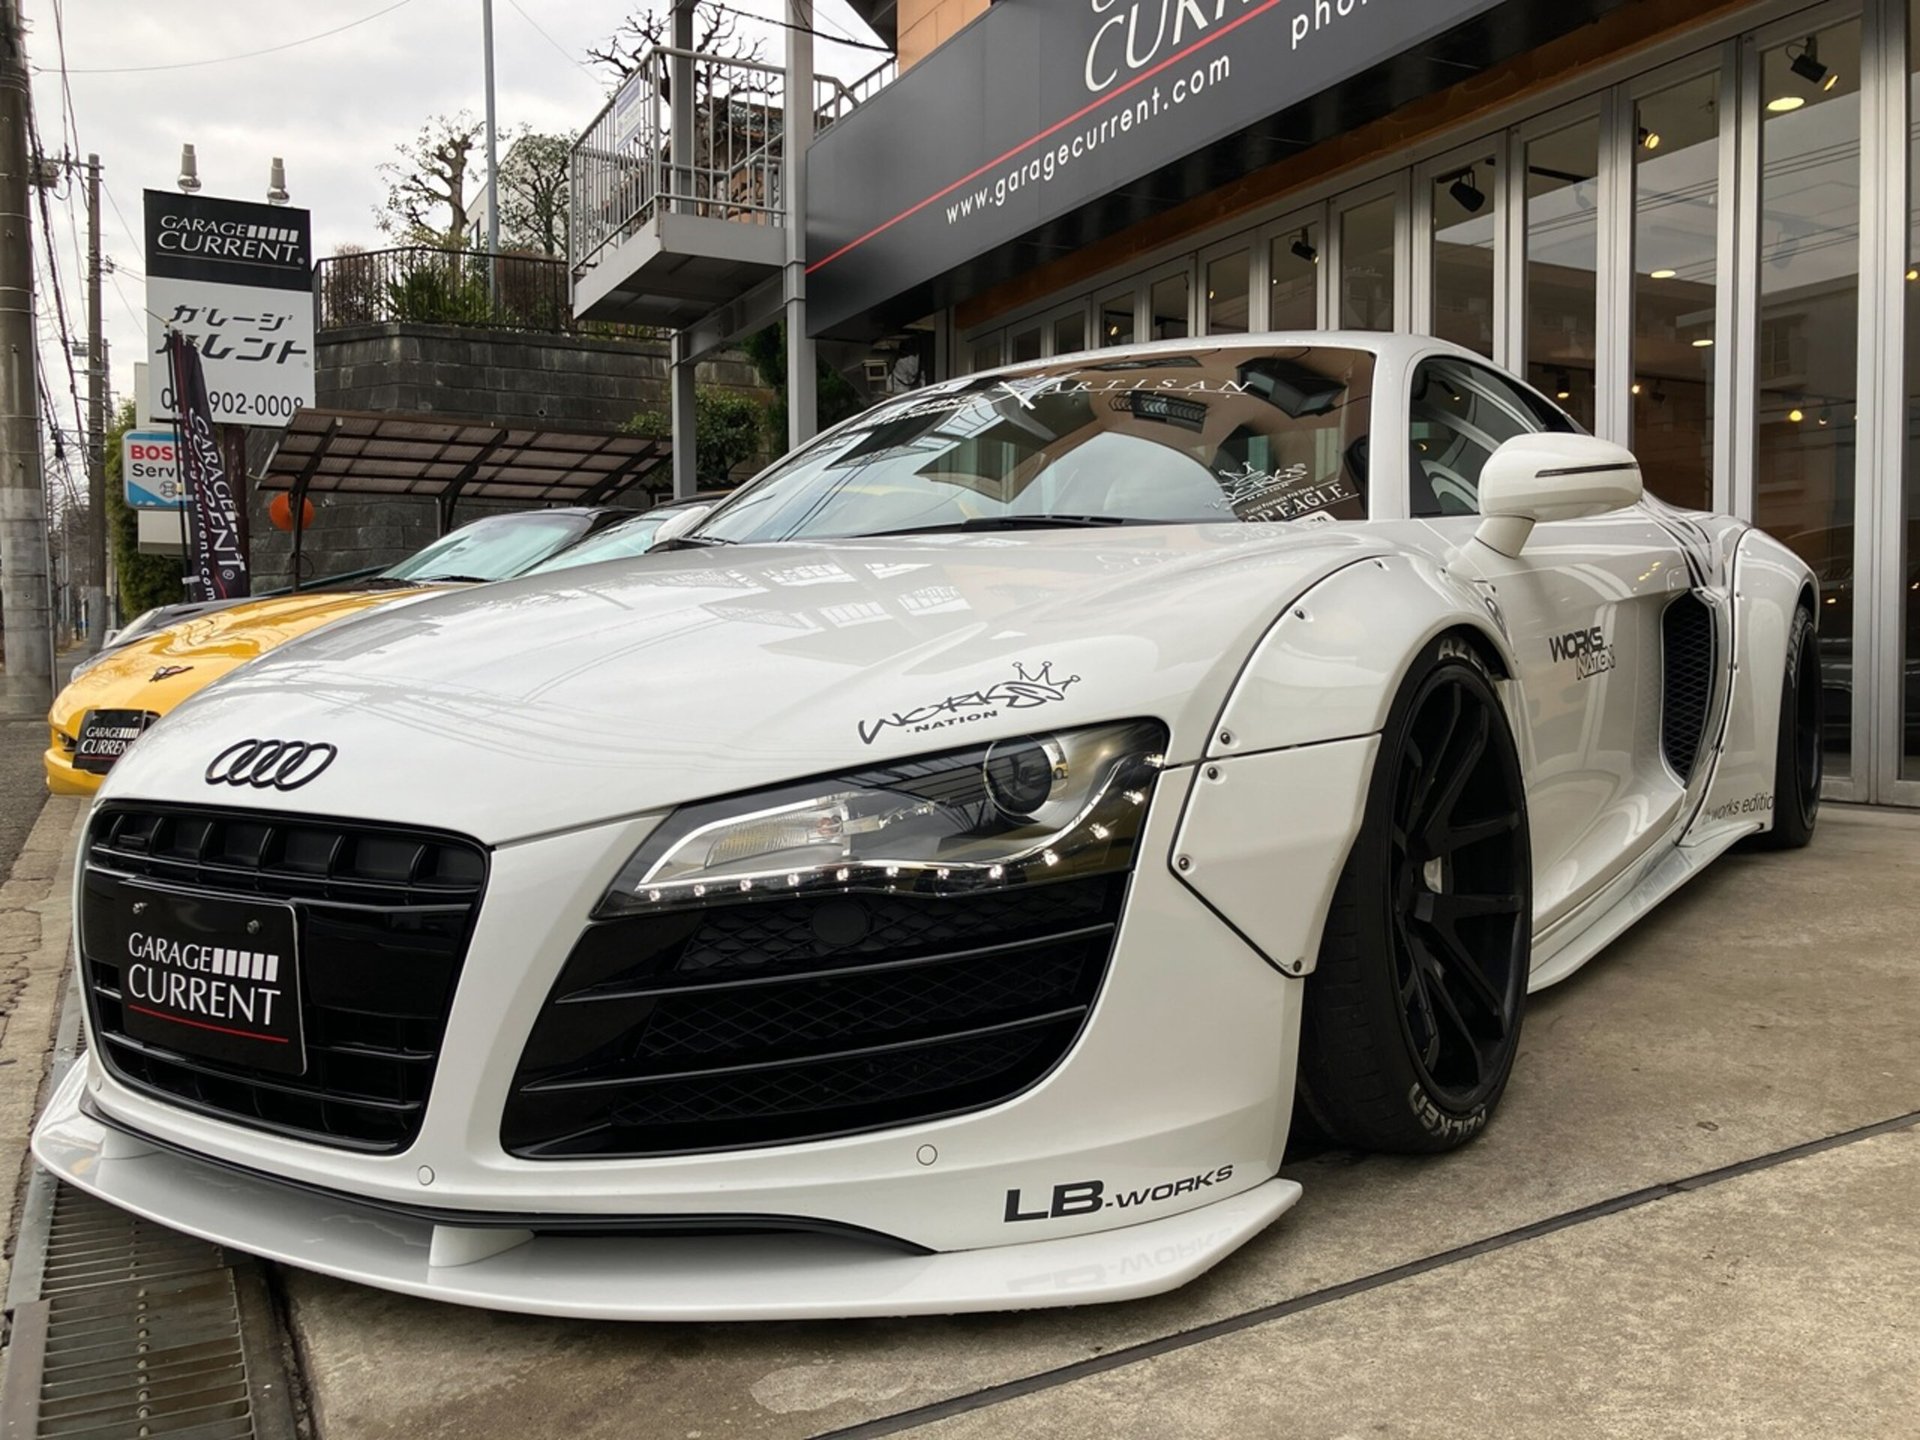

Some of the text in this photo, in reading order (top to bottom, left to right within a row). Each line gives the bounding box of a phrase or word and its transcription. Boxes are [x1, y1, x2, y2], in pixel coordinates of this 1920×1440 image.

[1291, 0, 1367, 50] pho
[945, 54, 1230, 225] www.garagecurrent.com
[160, 214, 247, 237] GARAGE
[157, 230, 299, 262] CURRENT
[169, 304, 293, 331] ガレージ
[131, 444, 174, 461] BOS
[196, 415, 236, 511] GARAGE
[132, 463, 175, 477] Serv
[1276, 483, 1349, 517] EAGLE
[1549, 626, 1603, 663] WORKS
[86, 727, 121, 738] GARAGE
[913, 710, 998, 733] NATION
[81, 739, 134, 755] CURREN
[128, 932, 212, 972] GARAGE
[128, 963, 281, 1026] CURRENT
[1003, 1164, 1234, 1223] LB-WORKS
